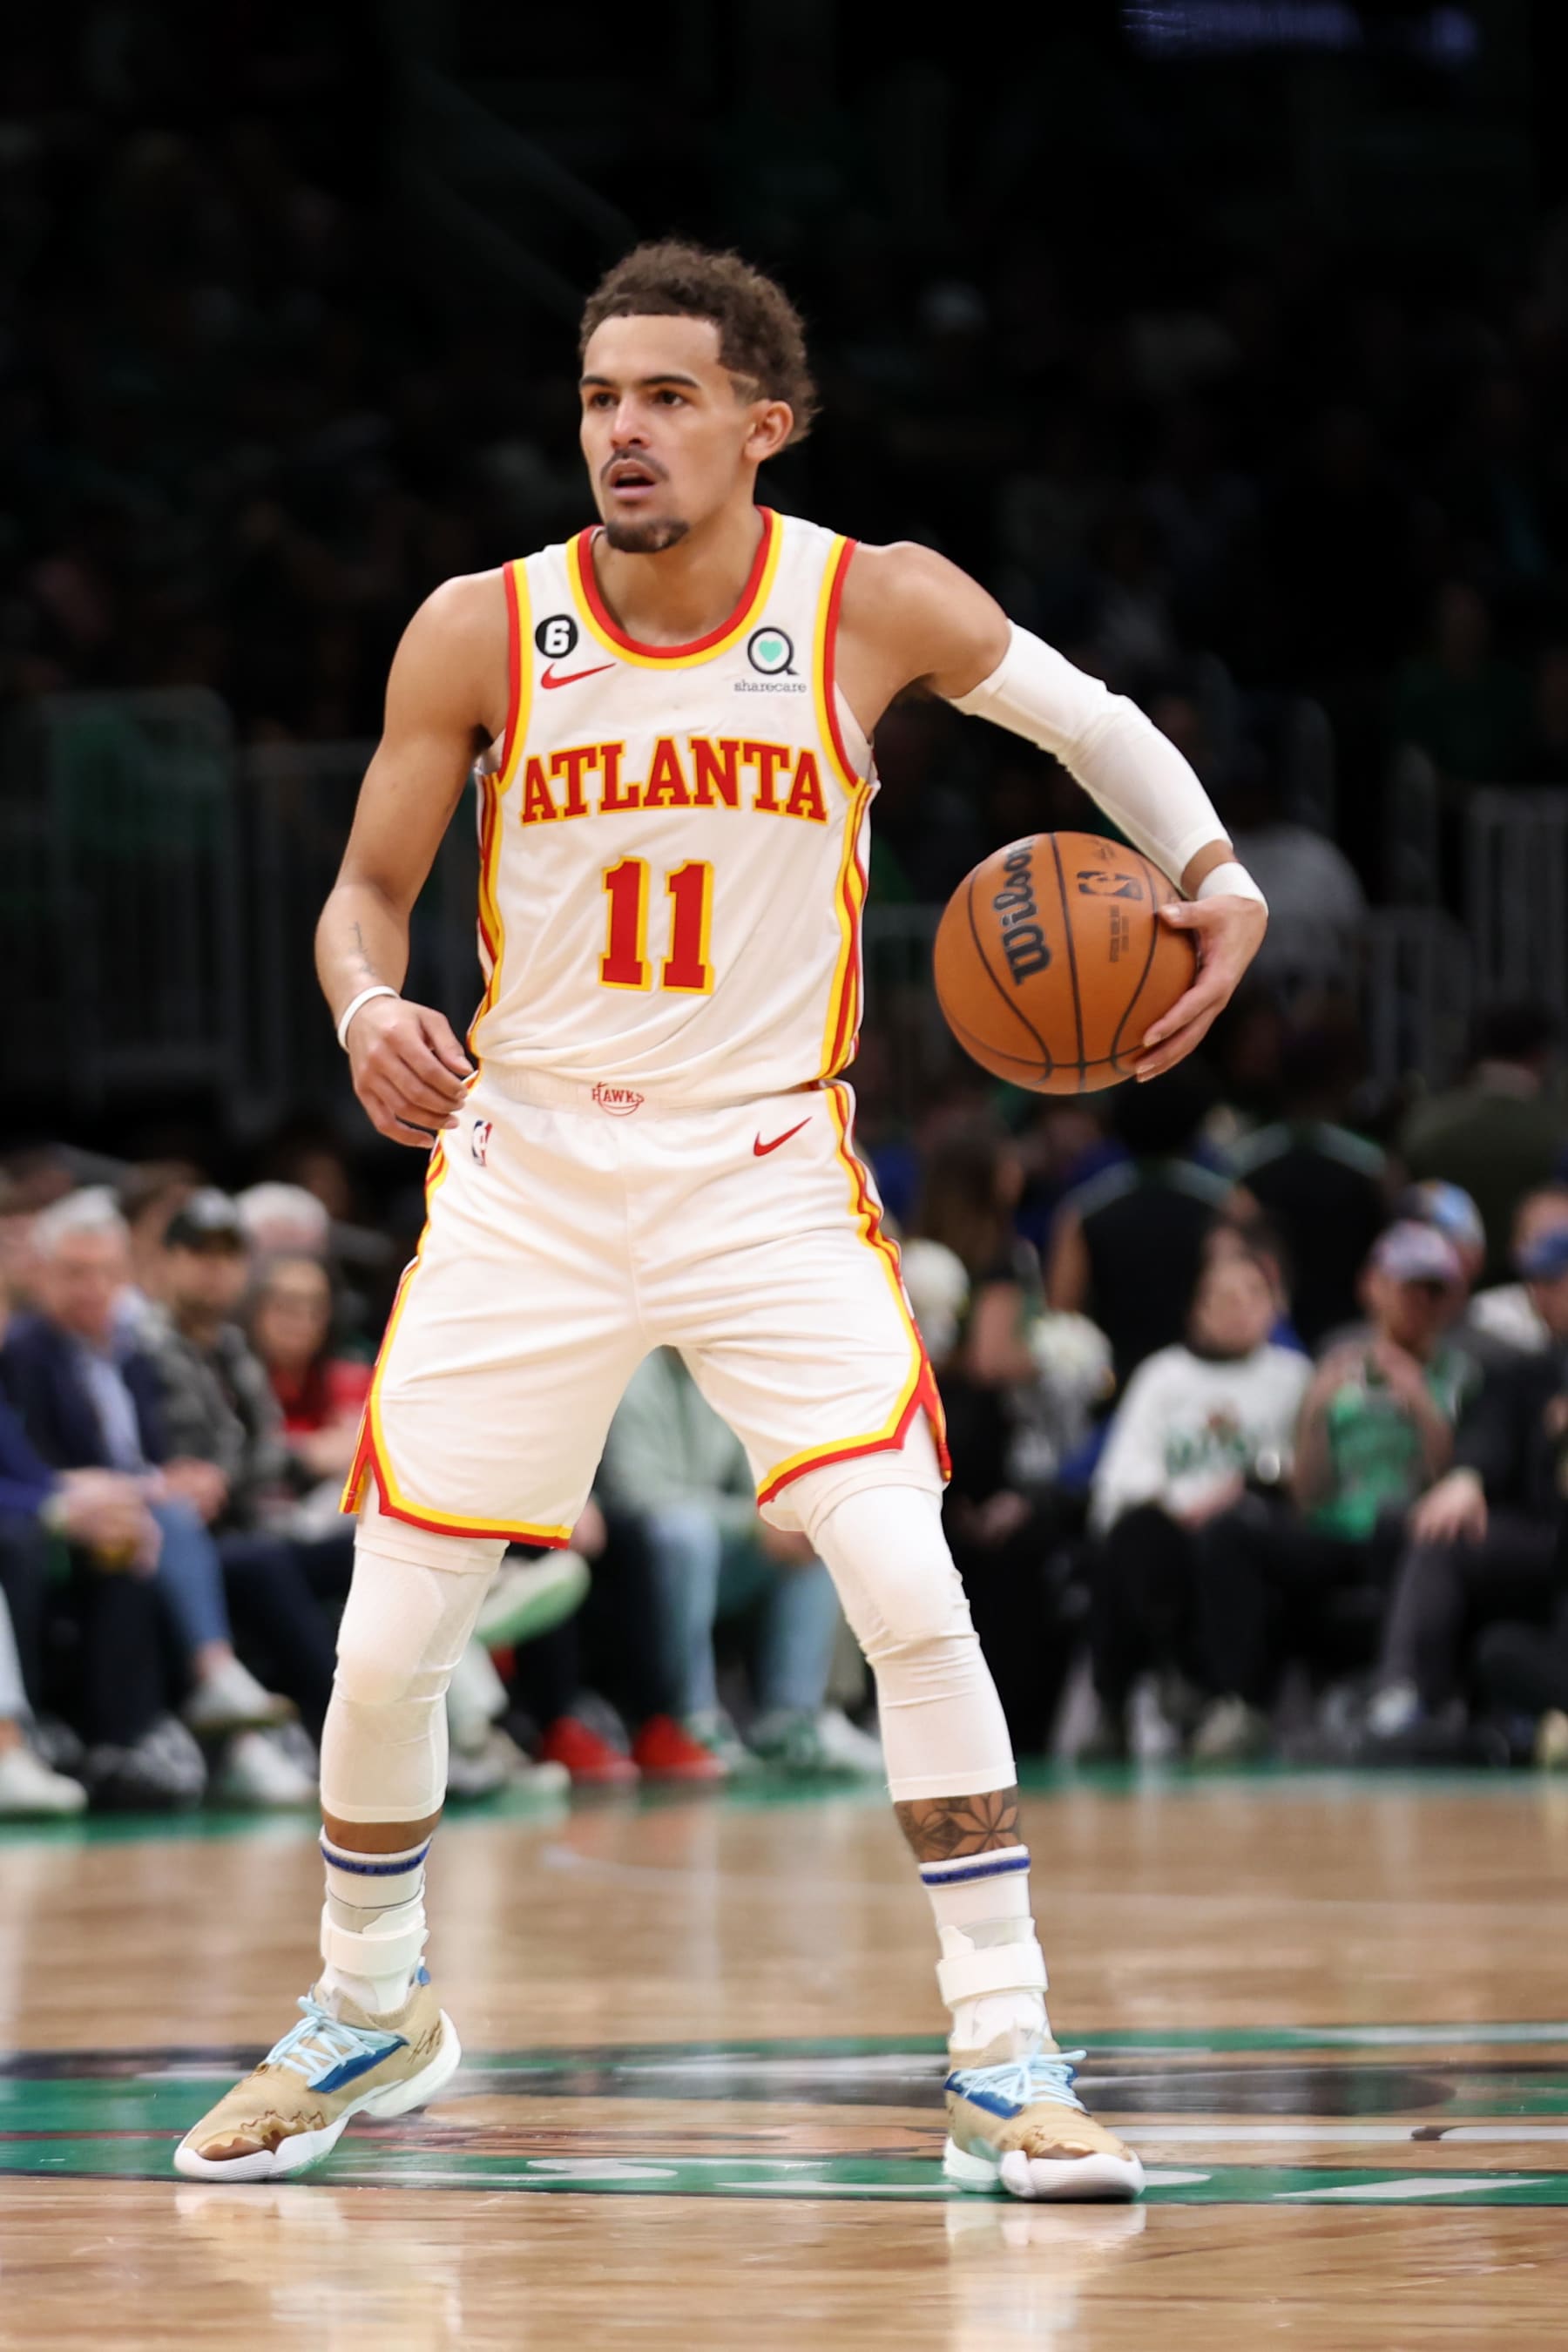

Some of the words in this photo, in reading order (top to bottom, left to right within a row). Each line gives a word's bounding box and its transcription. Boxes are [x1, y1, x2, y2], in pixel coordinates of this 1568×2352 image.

[544, 619, 570, 654] 6
[733, 679, 808, 693] sharecare
[521, 736, 828, 826] ATLANTA
[599, 856, 714, 994] 11
[591, 1084, 645, 1104] HAWKS
